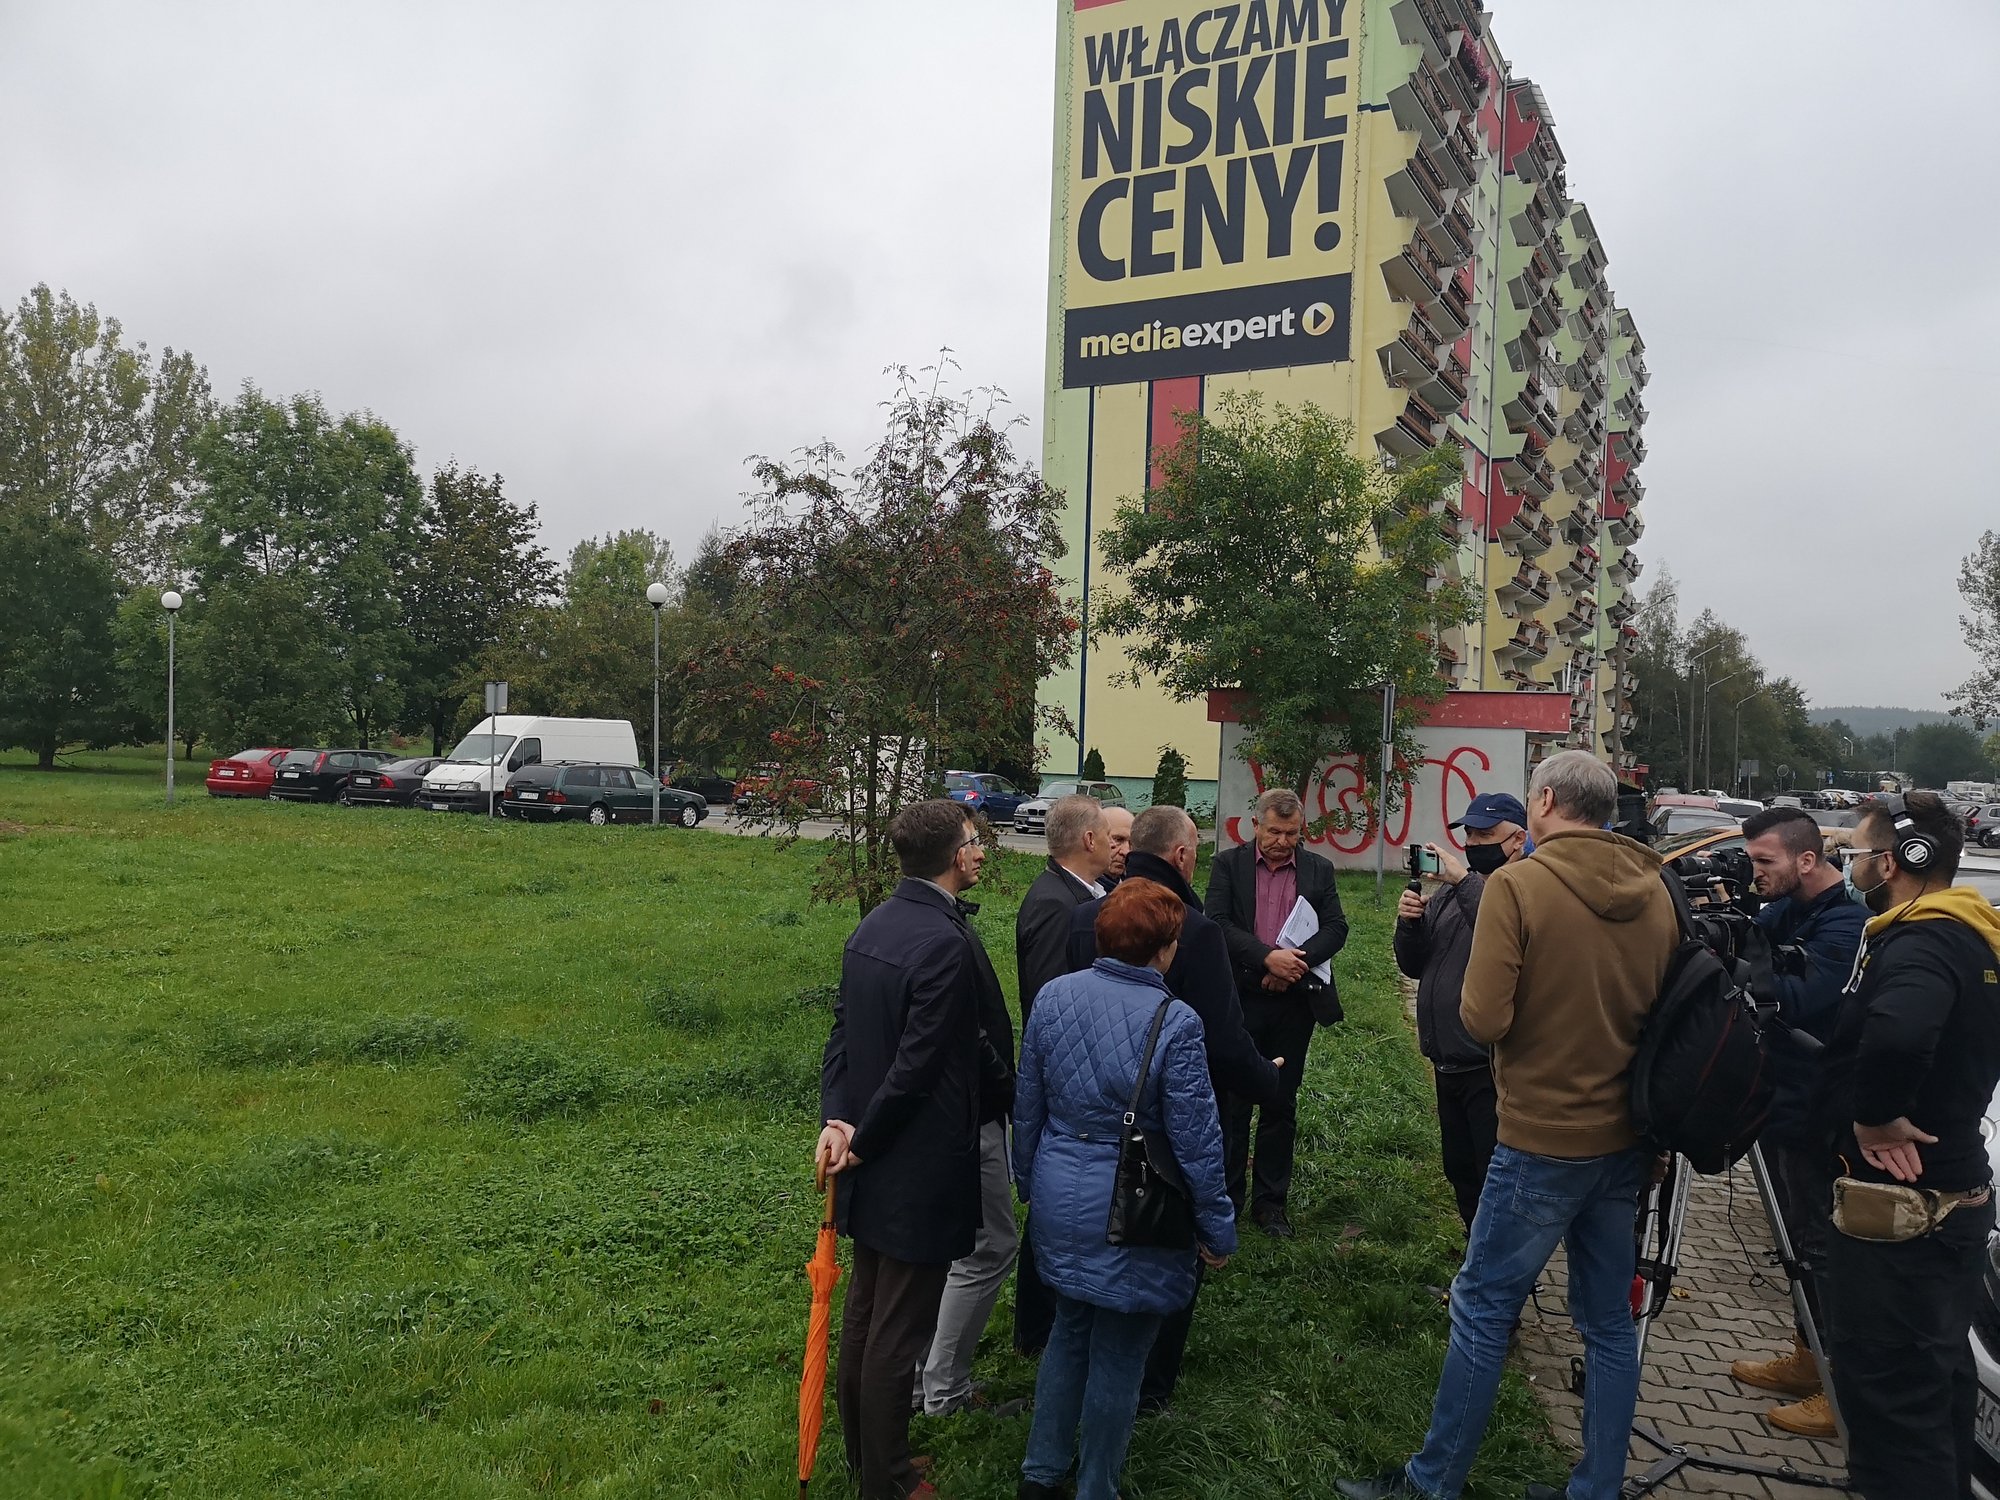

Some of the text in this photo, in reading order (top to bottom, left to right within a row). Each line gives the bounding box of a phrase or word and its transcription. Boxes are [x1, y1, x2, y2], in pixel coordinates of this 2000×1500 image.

[1084, 0, 1349, 87] WŁĄCZAMY
[1081, 38, 1349, 180] NISKIE
[1077, 139, 1344, 282] CENY!
[1080, 307, 1295, 358] mediaexpert
